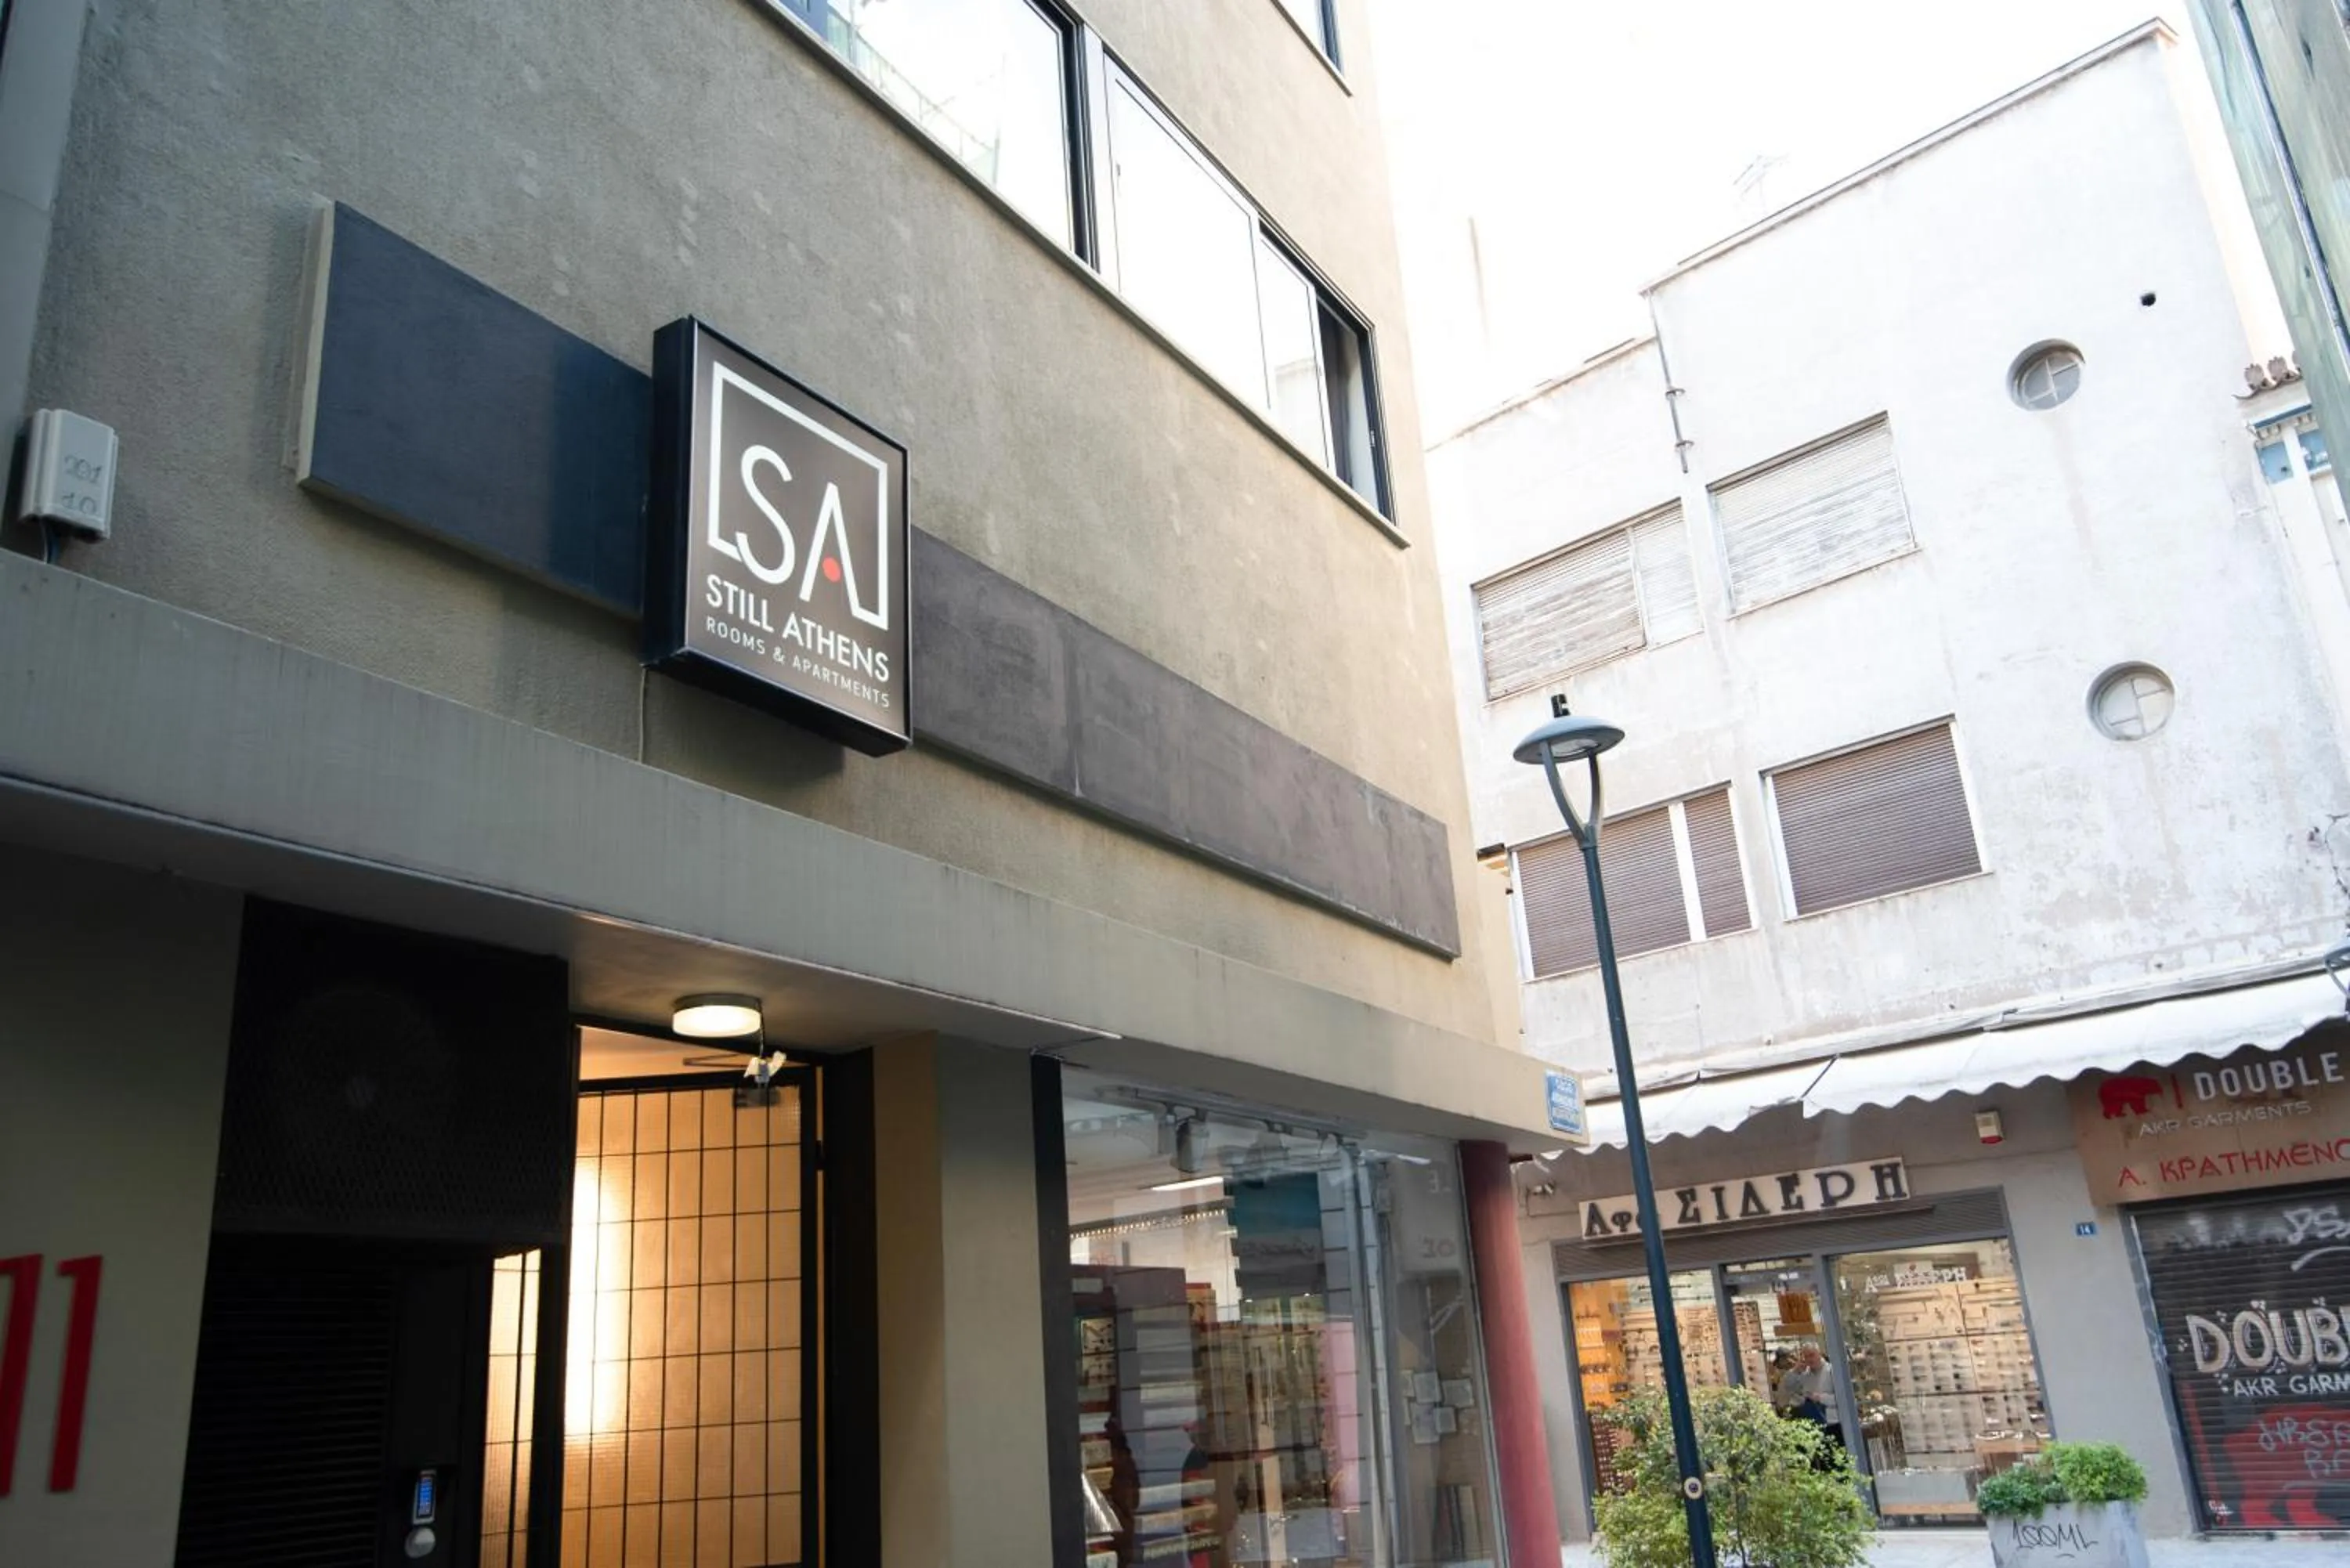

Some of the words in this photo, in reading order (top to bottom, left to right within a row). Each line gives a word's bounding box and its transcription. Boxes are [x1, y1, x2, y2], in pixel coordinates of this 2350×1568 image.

[707, 574, 774, 633] STILL
[782, 612, 889, 682] ATHENS
[707, 616, 765, 655] ROOMS
[772, 646, 785, 665] &
[793, 655, 890, 708] APARTMENTS
[2193, 1052, 2345, 1100] DOUBLE
[2187, 1100, 2312, 1128] GARMENTS
[1676, 1161, 1908, 1225] ΣΙΔΕΡΗ
[2233, 1377, 2280, 1397] AKR
